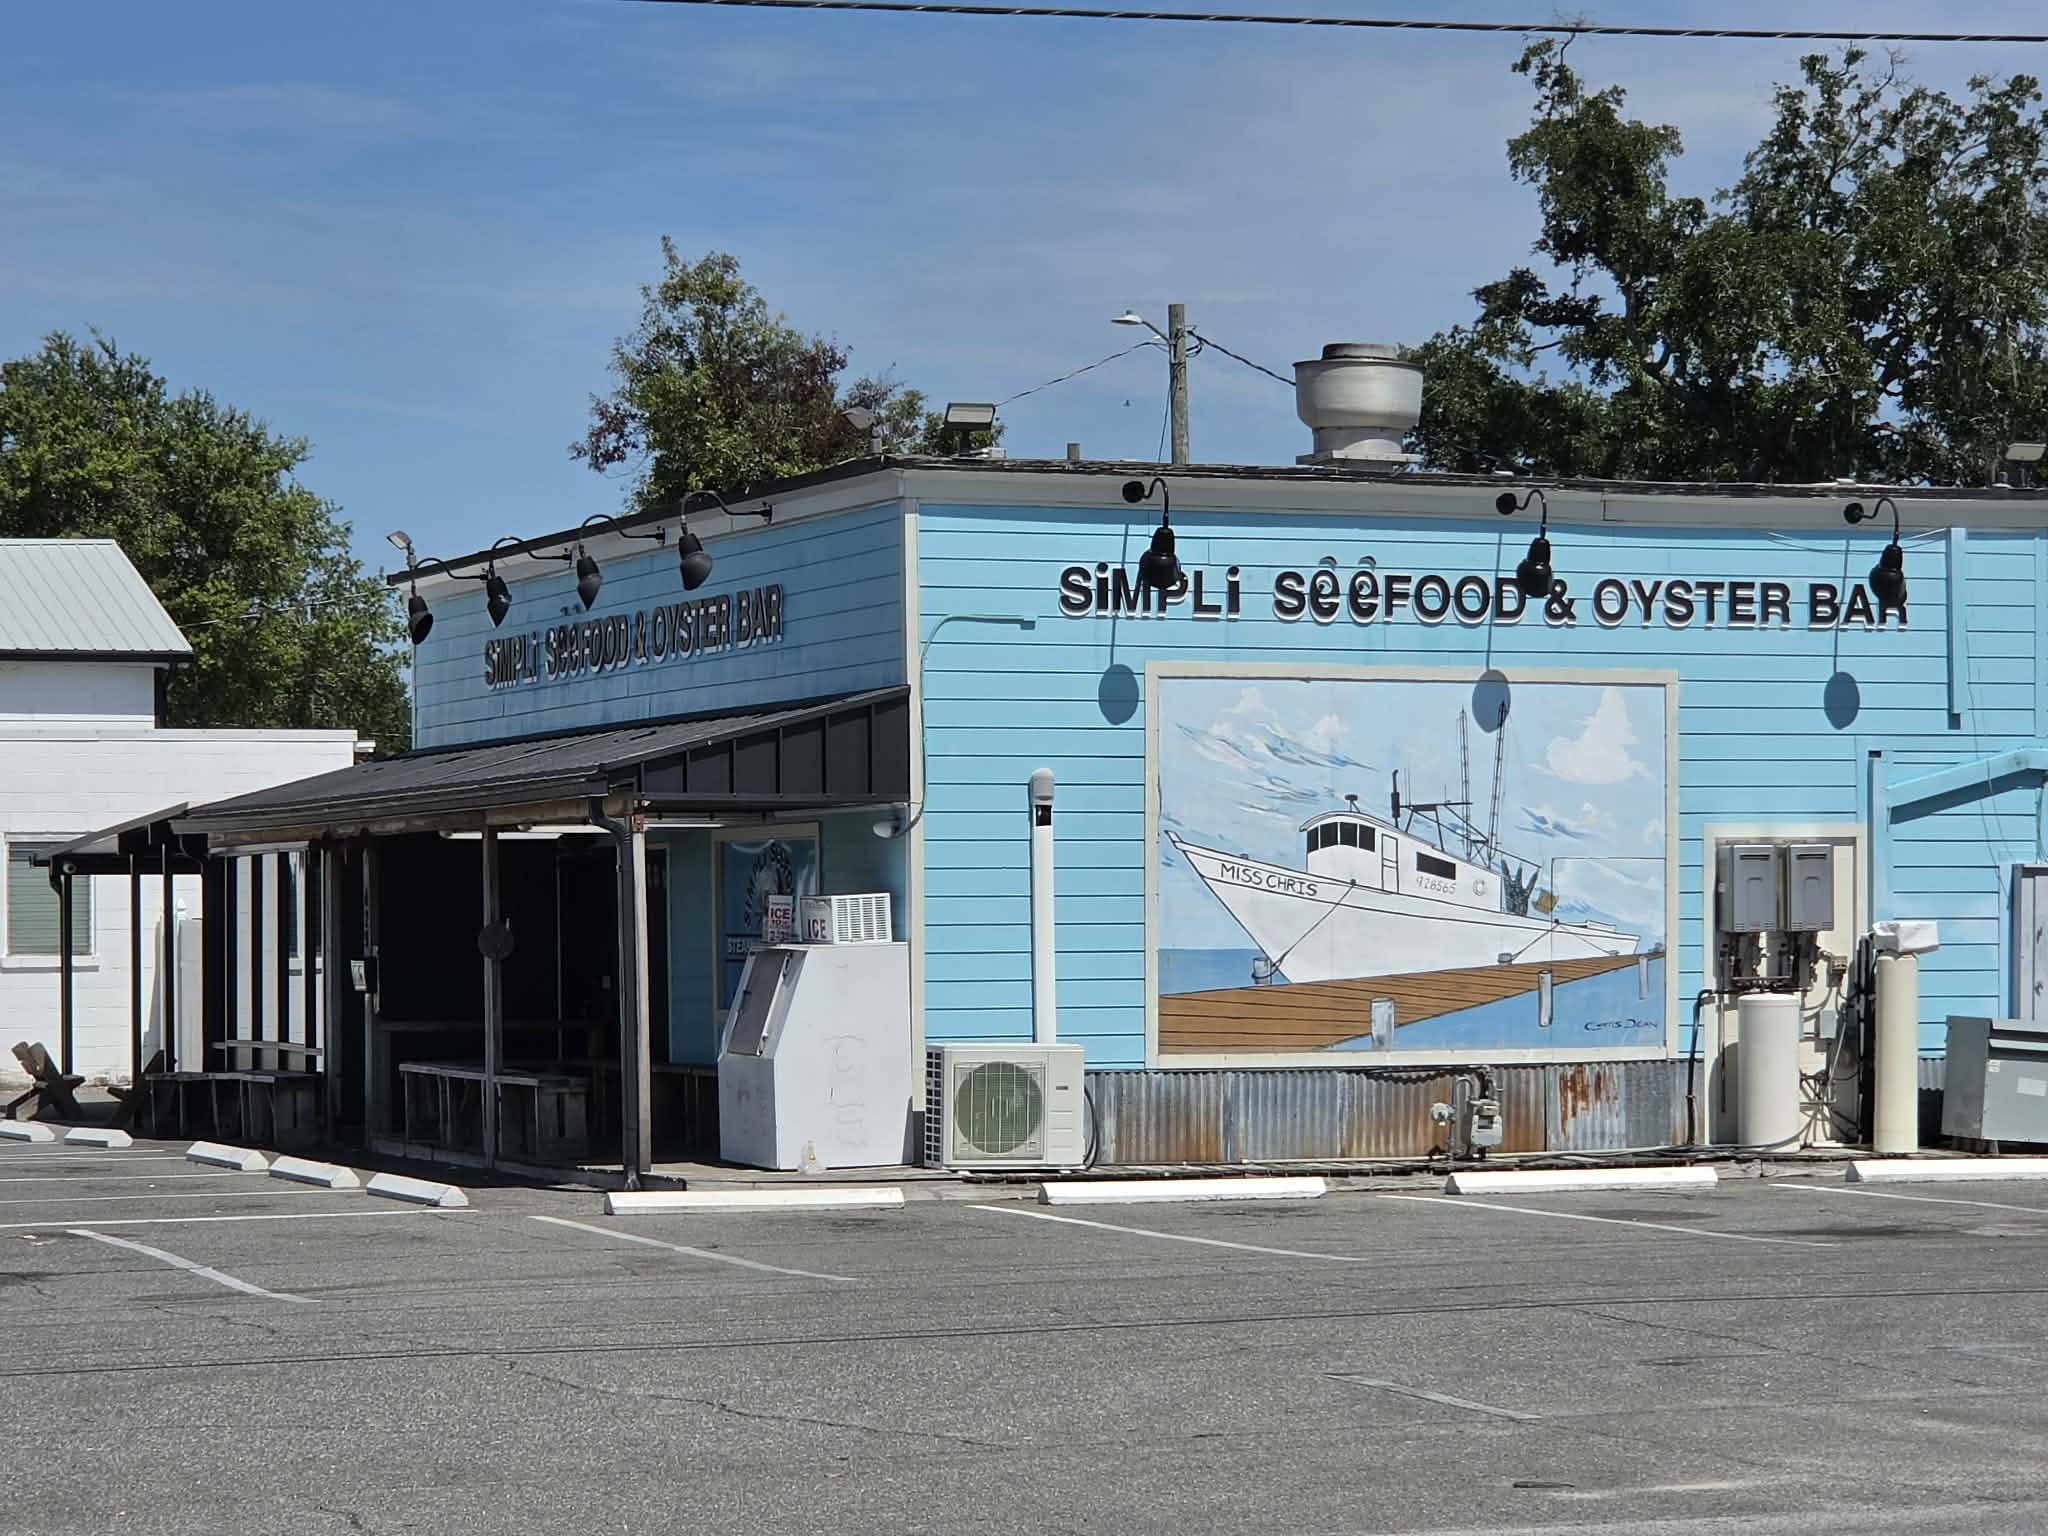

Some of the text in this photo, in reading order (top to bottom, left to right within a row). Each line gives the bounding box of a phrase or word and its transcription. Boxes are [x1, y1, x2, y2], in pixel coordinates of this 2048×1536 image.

[1544, 579, 1577, 625] &
[1593, 578, 1791, 628] OYSTER
[634, 609, 649, 665] &
[652, 594, 732, 661] OYSTER
[736, 583, 783, 650] BAR
[1221, 863, 1318, 897] MISS CHRIS
[770, 907, 791, 920] ICE
[807, 918, 827, 939] ICE
